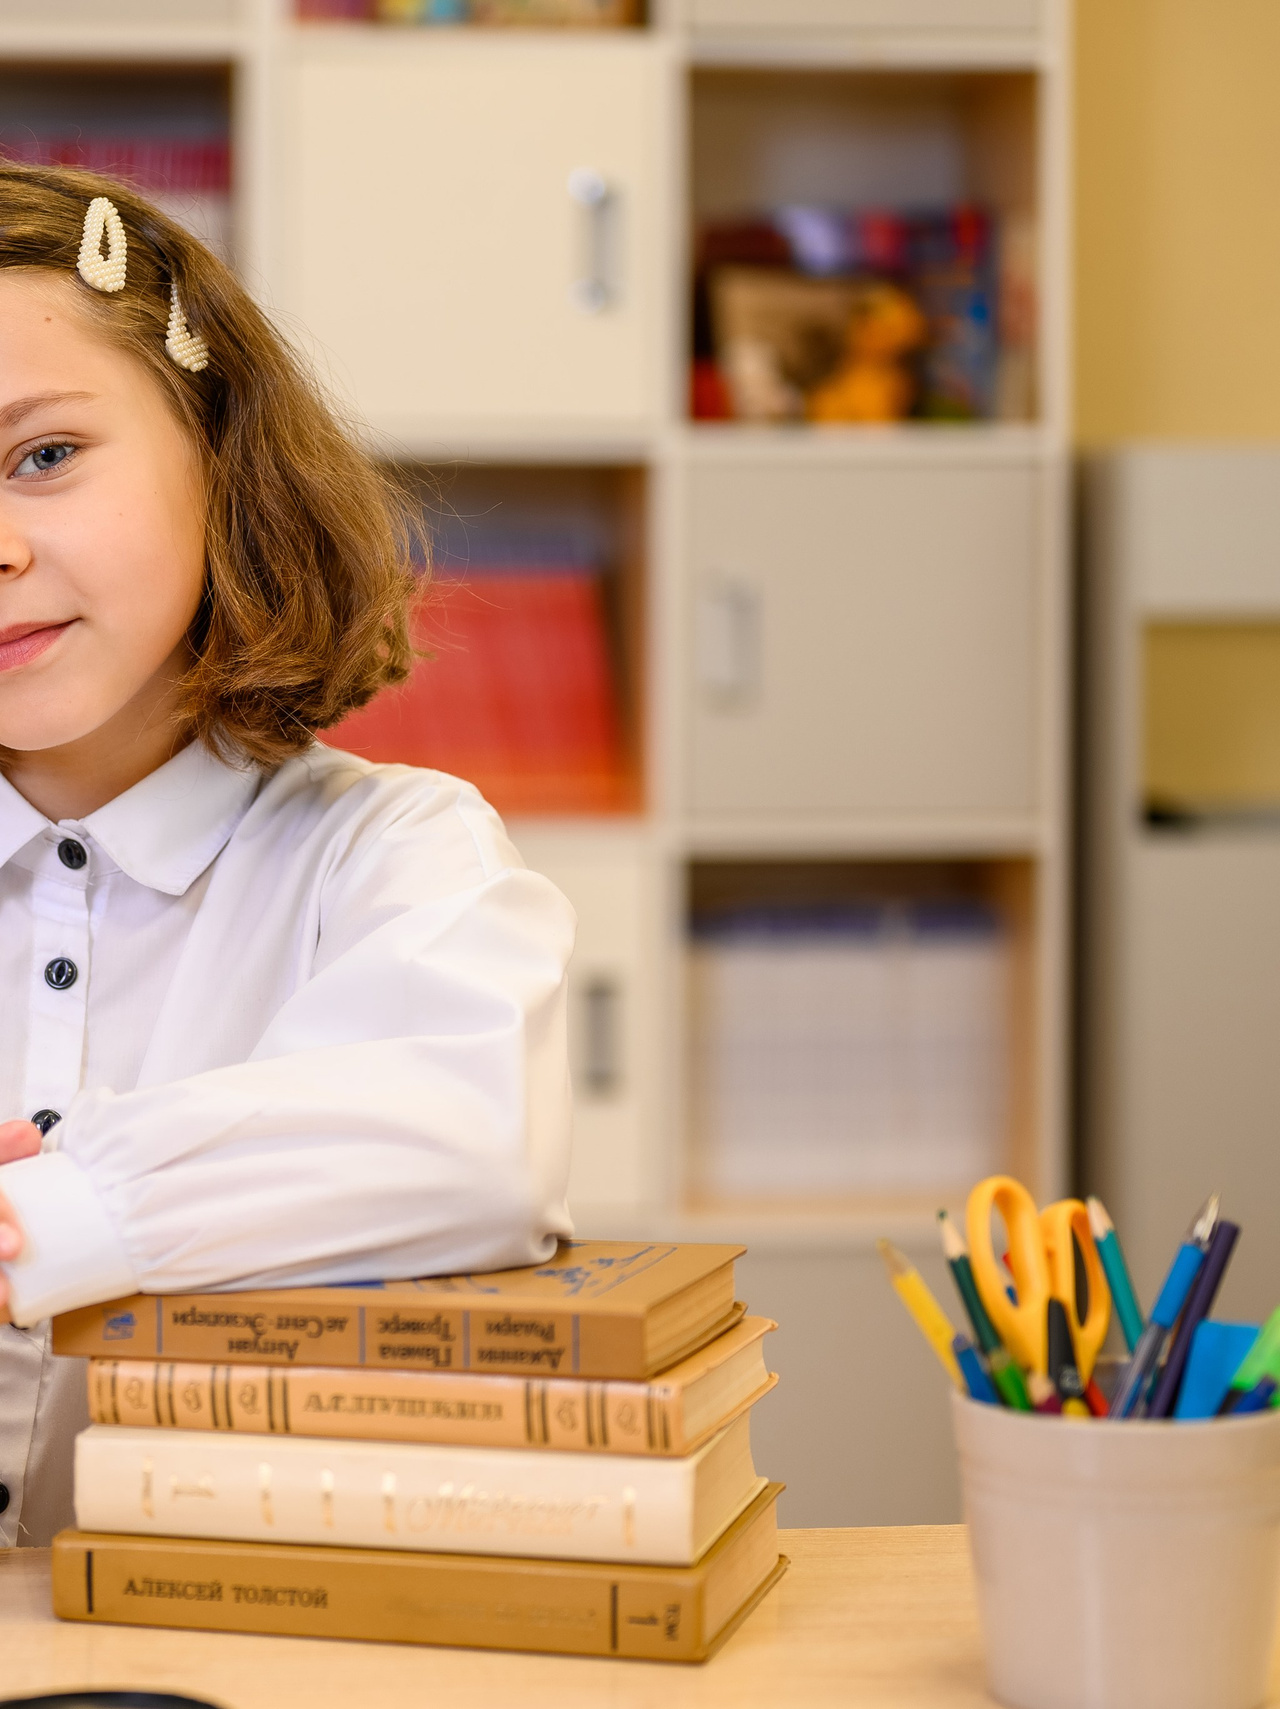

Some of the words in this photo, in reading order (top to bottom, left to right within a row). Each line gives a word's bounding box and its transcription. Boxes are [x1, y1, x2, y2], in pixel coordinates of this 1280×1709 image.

[485, 1314, 556, 1342] Родари
[378, 1344, 453, 1368] Памела
[477, 1346, 565, 1371] Джанни
[123, 1577, 223, 1602] АЛЕКСЕЙ
[231, 1584, 329, 1610] ТОЛСТОЙ
